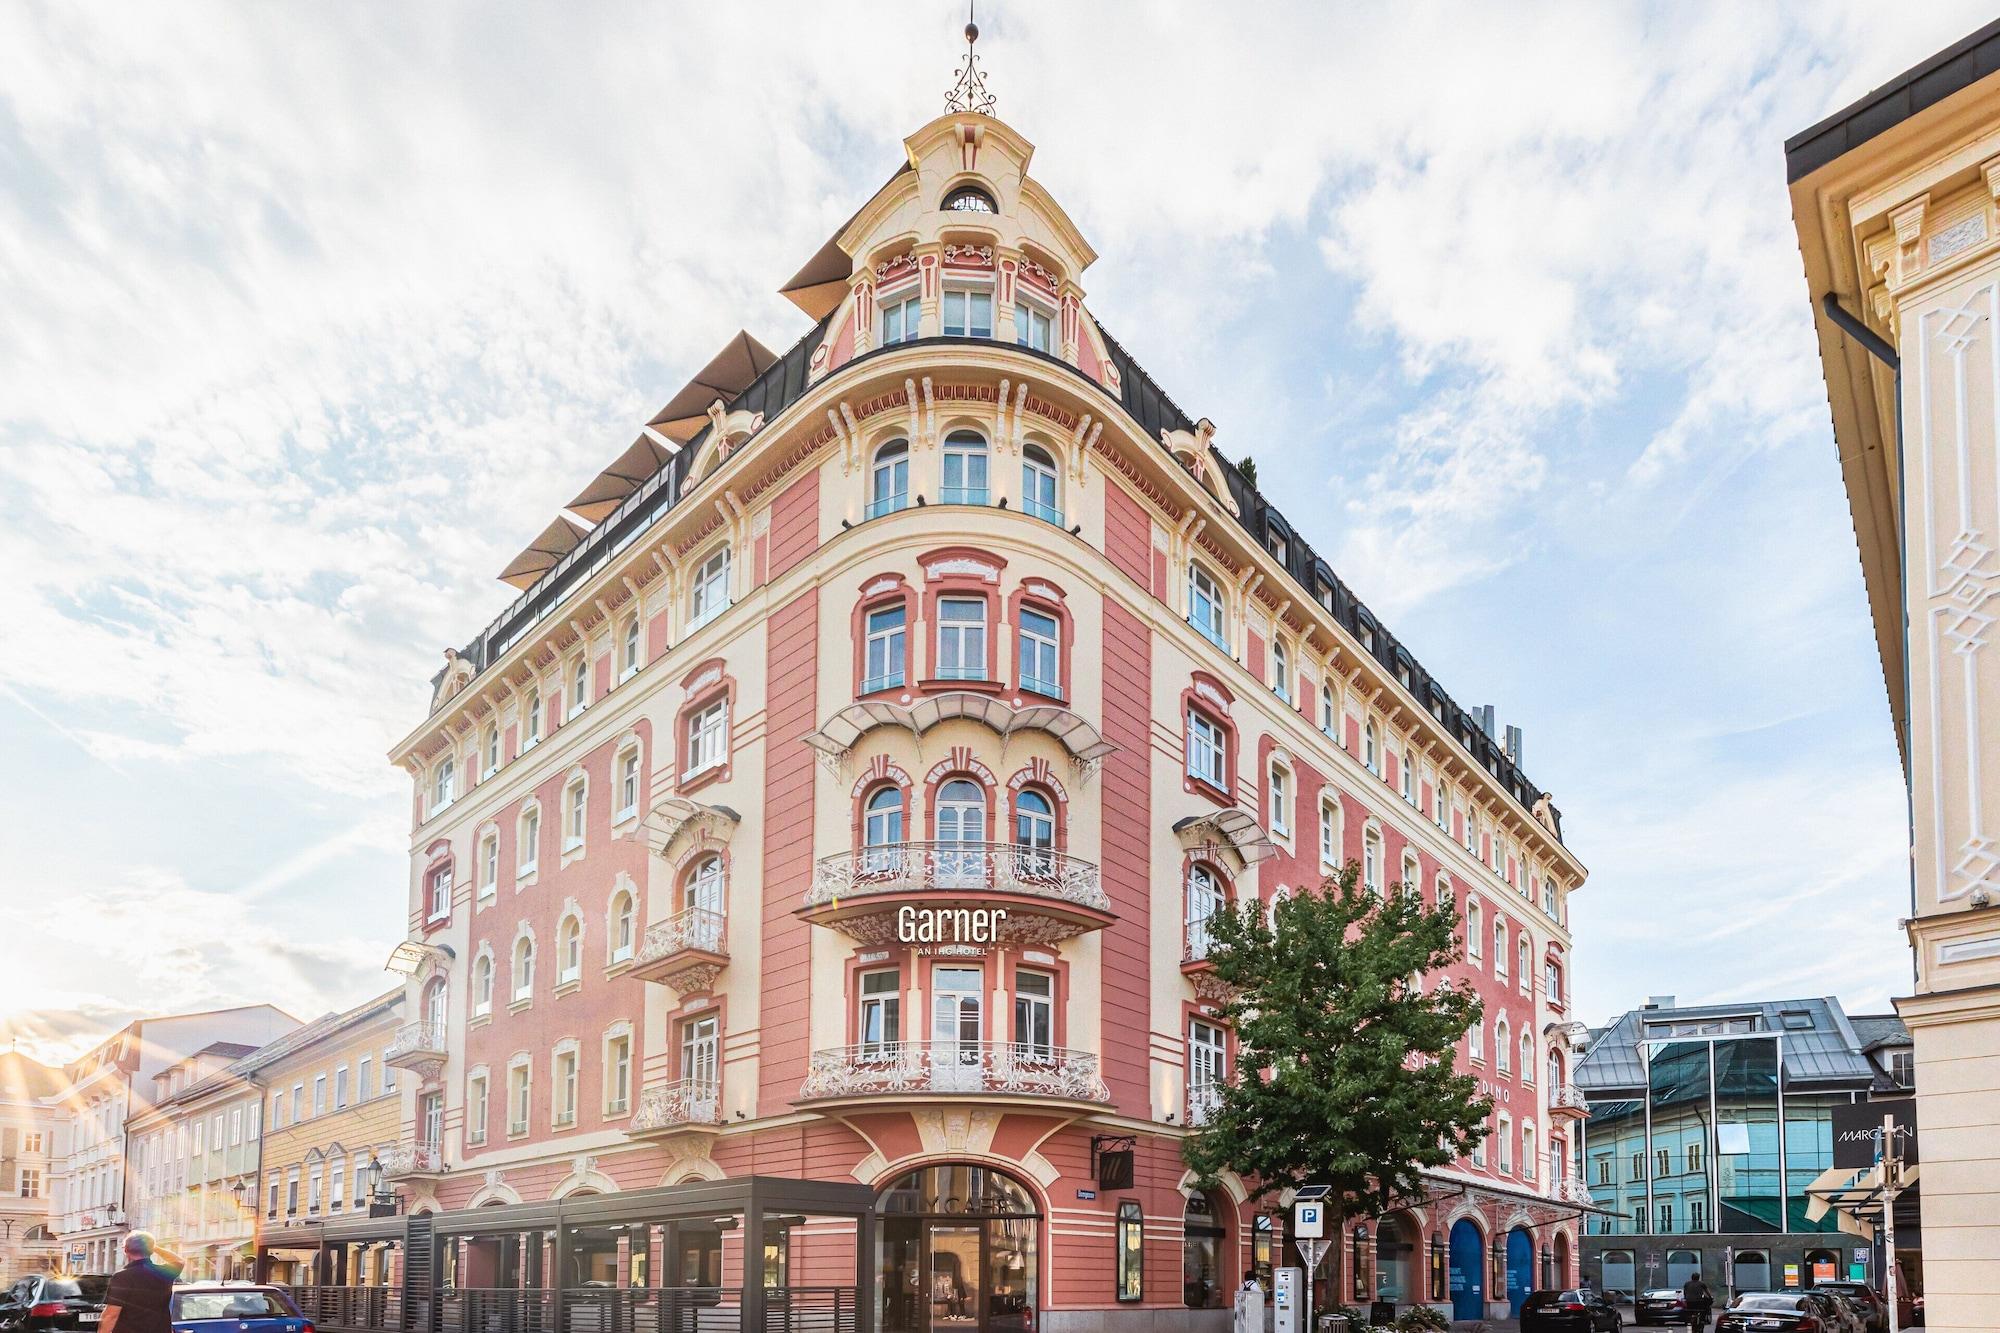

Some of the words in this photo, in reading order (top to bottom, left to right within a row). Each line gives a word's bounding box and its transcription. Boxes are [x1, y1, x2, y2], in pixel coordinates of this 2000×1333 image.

[899, 906, 1007, 942] Garner
[957, 948, 987, 956] HOTEL
[1304, 1210, 1315, 1222] P
